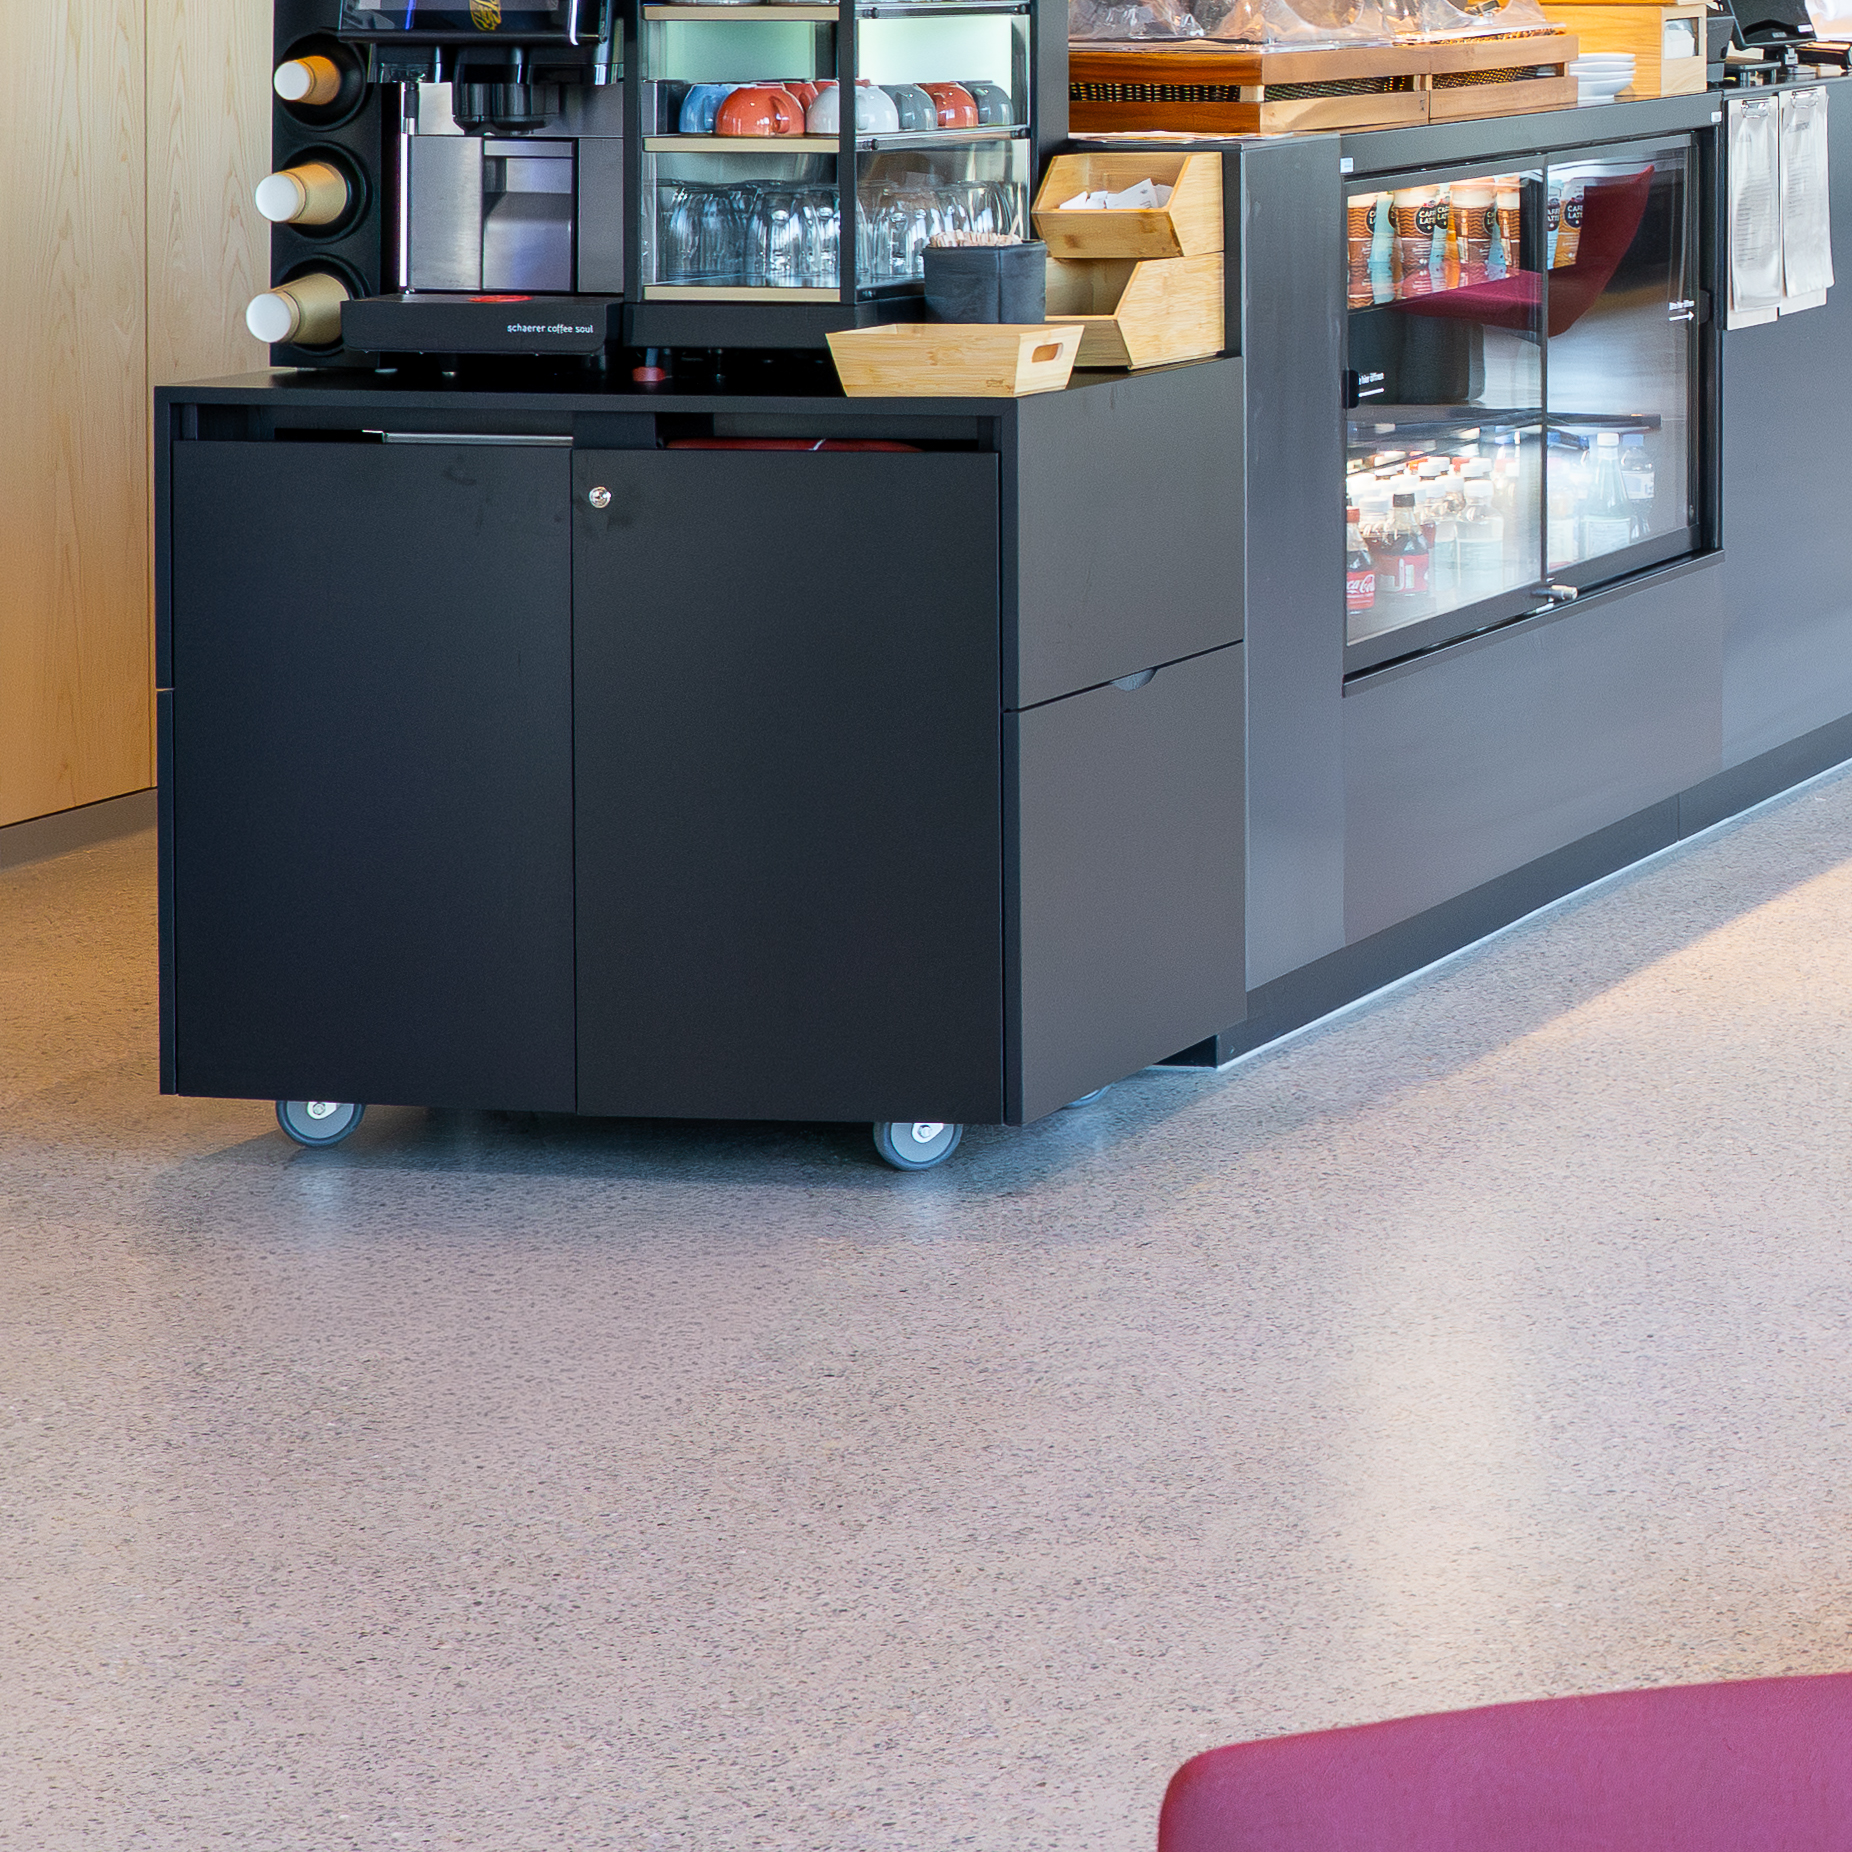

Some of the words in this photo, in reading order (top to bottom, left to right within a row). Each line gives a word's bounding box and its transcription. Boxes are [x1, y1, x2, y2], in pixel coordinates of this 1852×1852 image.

[507, 323, 546, 333] schaerer
[547, 324, 573, 334] coffee
[575, 325, 594, 333] soul
